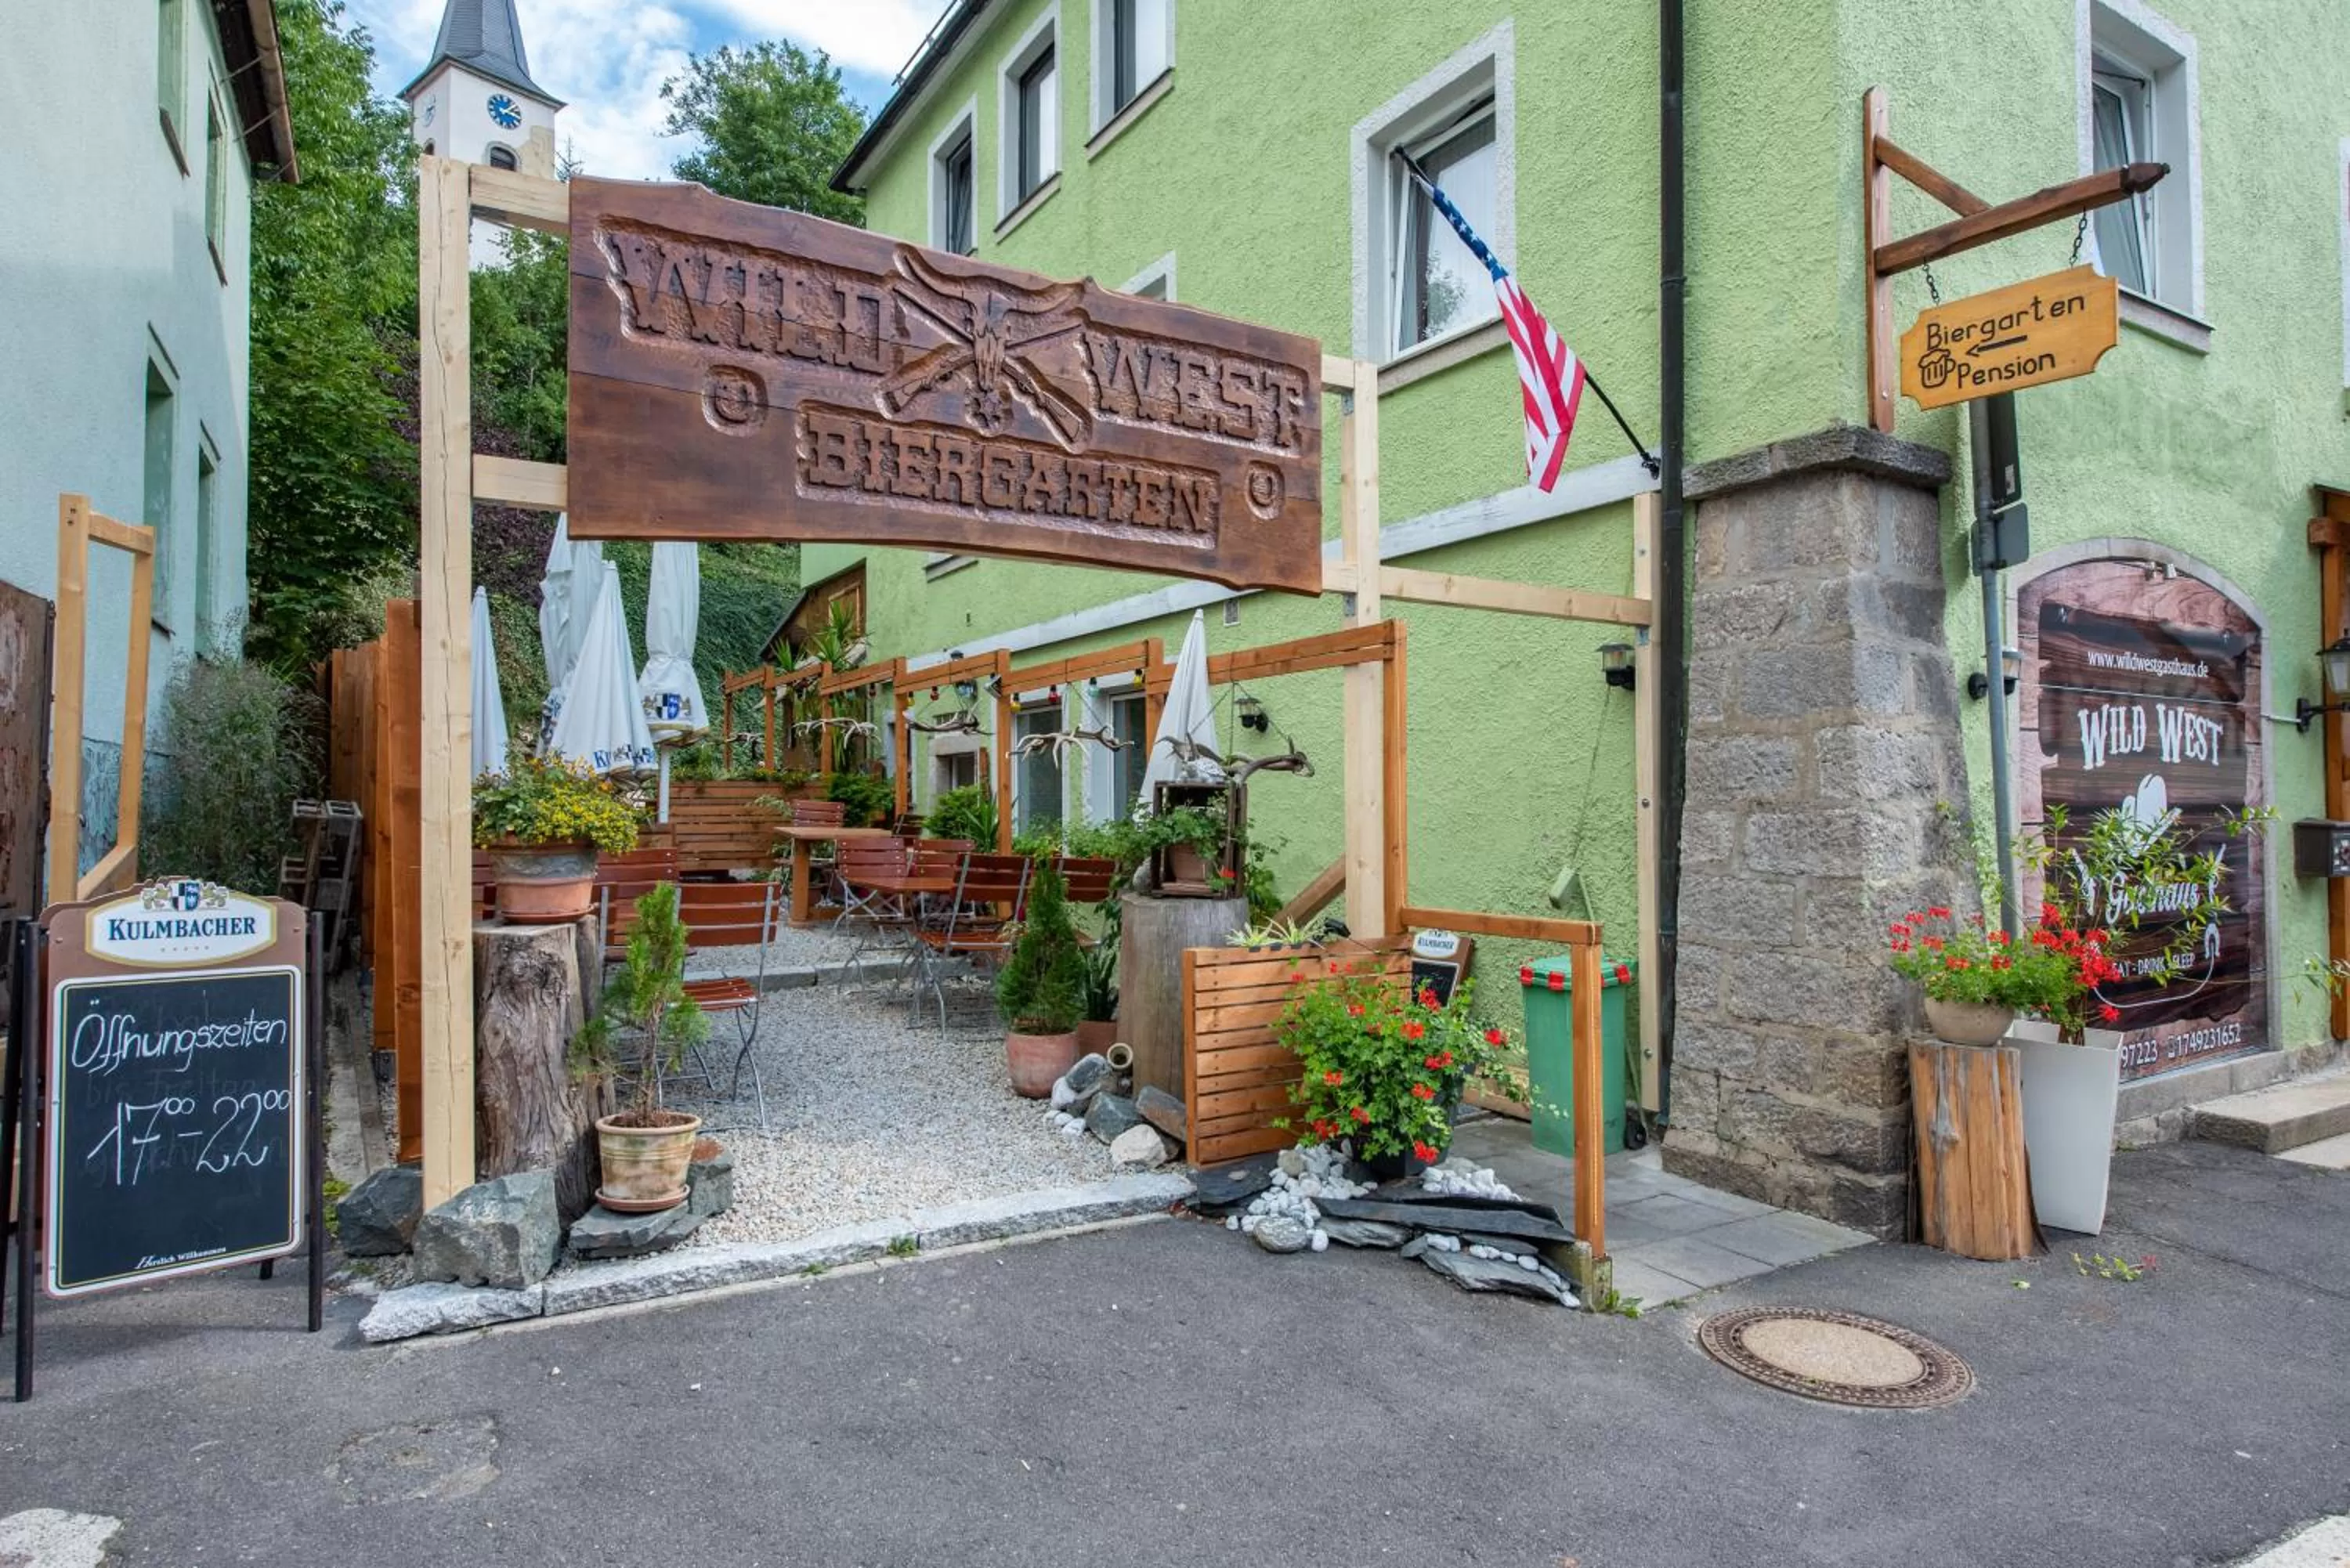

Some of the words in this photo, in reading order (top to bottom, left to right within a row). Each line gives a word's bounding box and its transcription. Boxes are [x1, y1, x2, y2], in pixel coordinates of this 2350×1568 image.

[611, 231, 891, 376] WILD
[1079, 331, 1305, 449] WEST
[1926, 294, 2084, 352] Biergarten
[1958, 352, 2056, 388] Pension
[804, 411, 1211, 533] BIERGARTEN
[2087, 650, 2209, 678] www.wildwestgasthaus.de
[107, 916, 256, 941] KULMBACHER
[71, 999, 287, 1077] Öffnungszeiten
